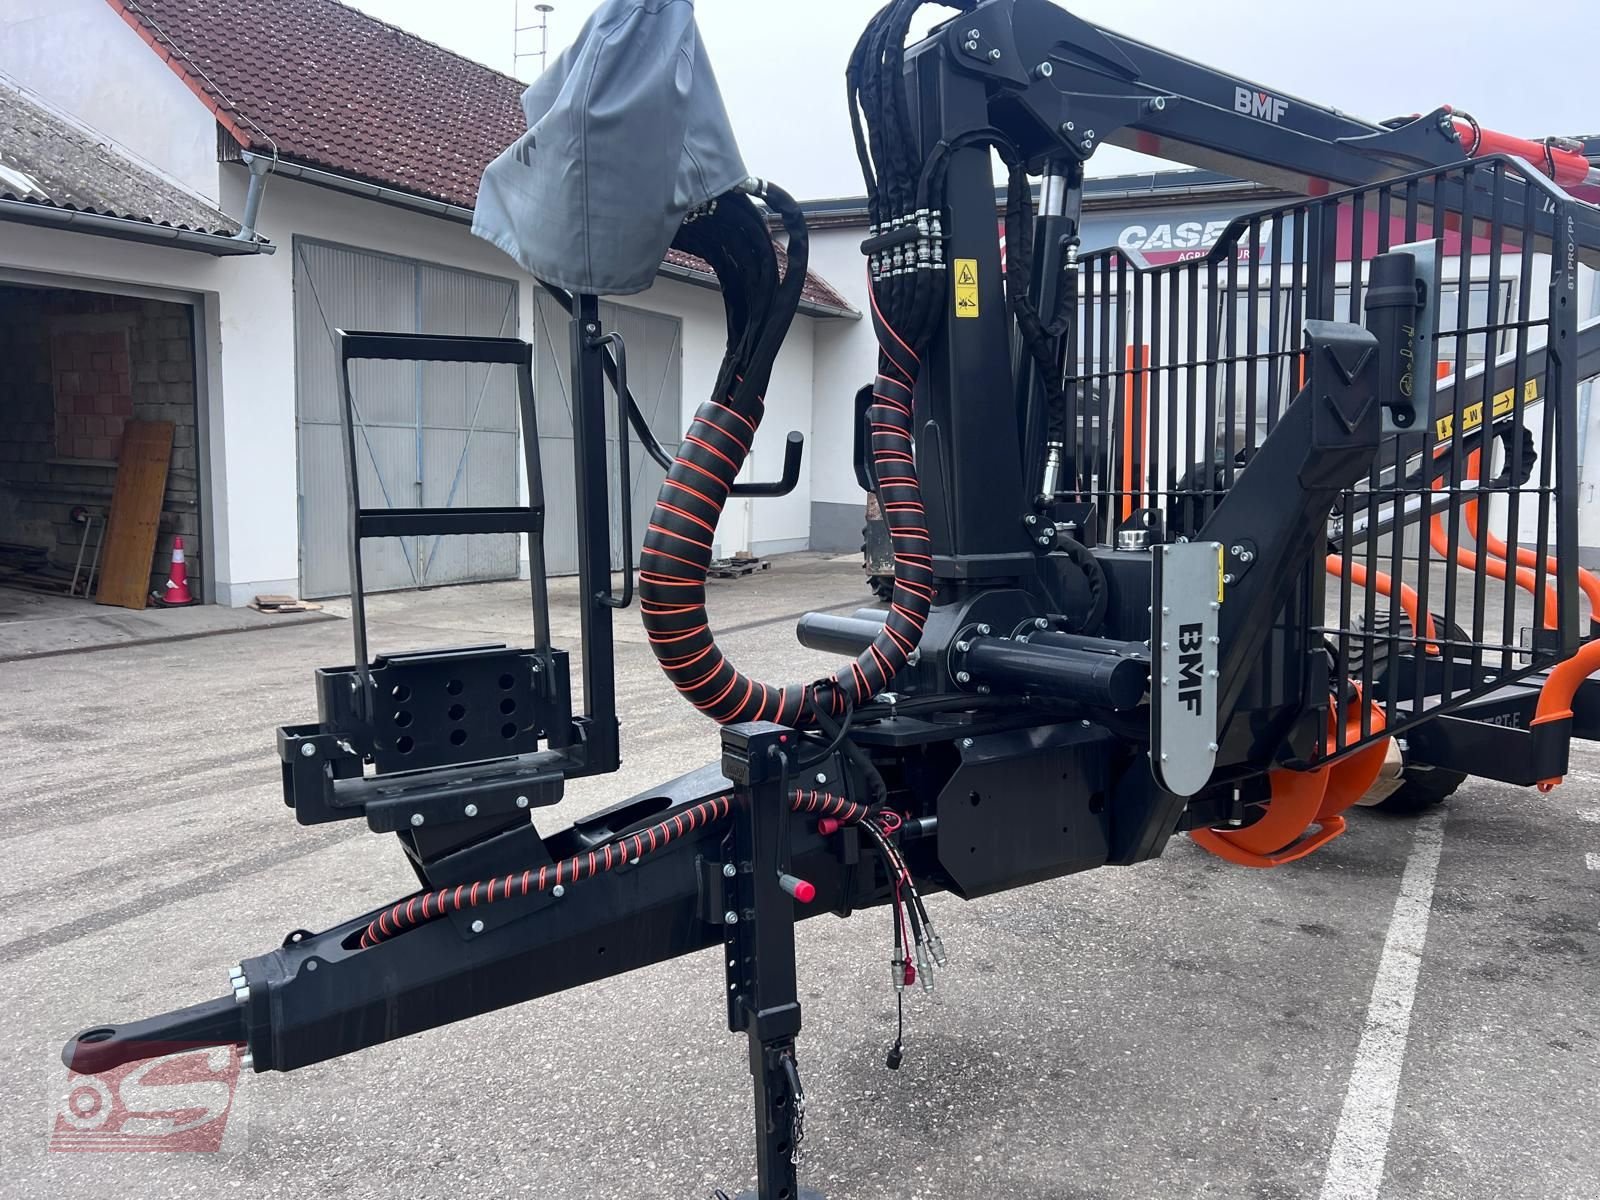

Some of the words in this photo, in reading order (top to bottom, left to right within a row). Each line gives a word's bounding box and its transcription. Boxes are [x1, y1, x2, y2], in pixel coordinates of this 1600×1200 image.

[1234, 86, 1289, 123] BMF
[1118, 219, 1231, 250] CASE
[1567, 215, 1575, 270] PRO/PP
[1178, 622, 1204, 717] BMF
